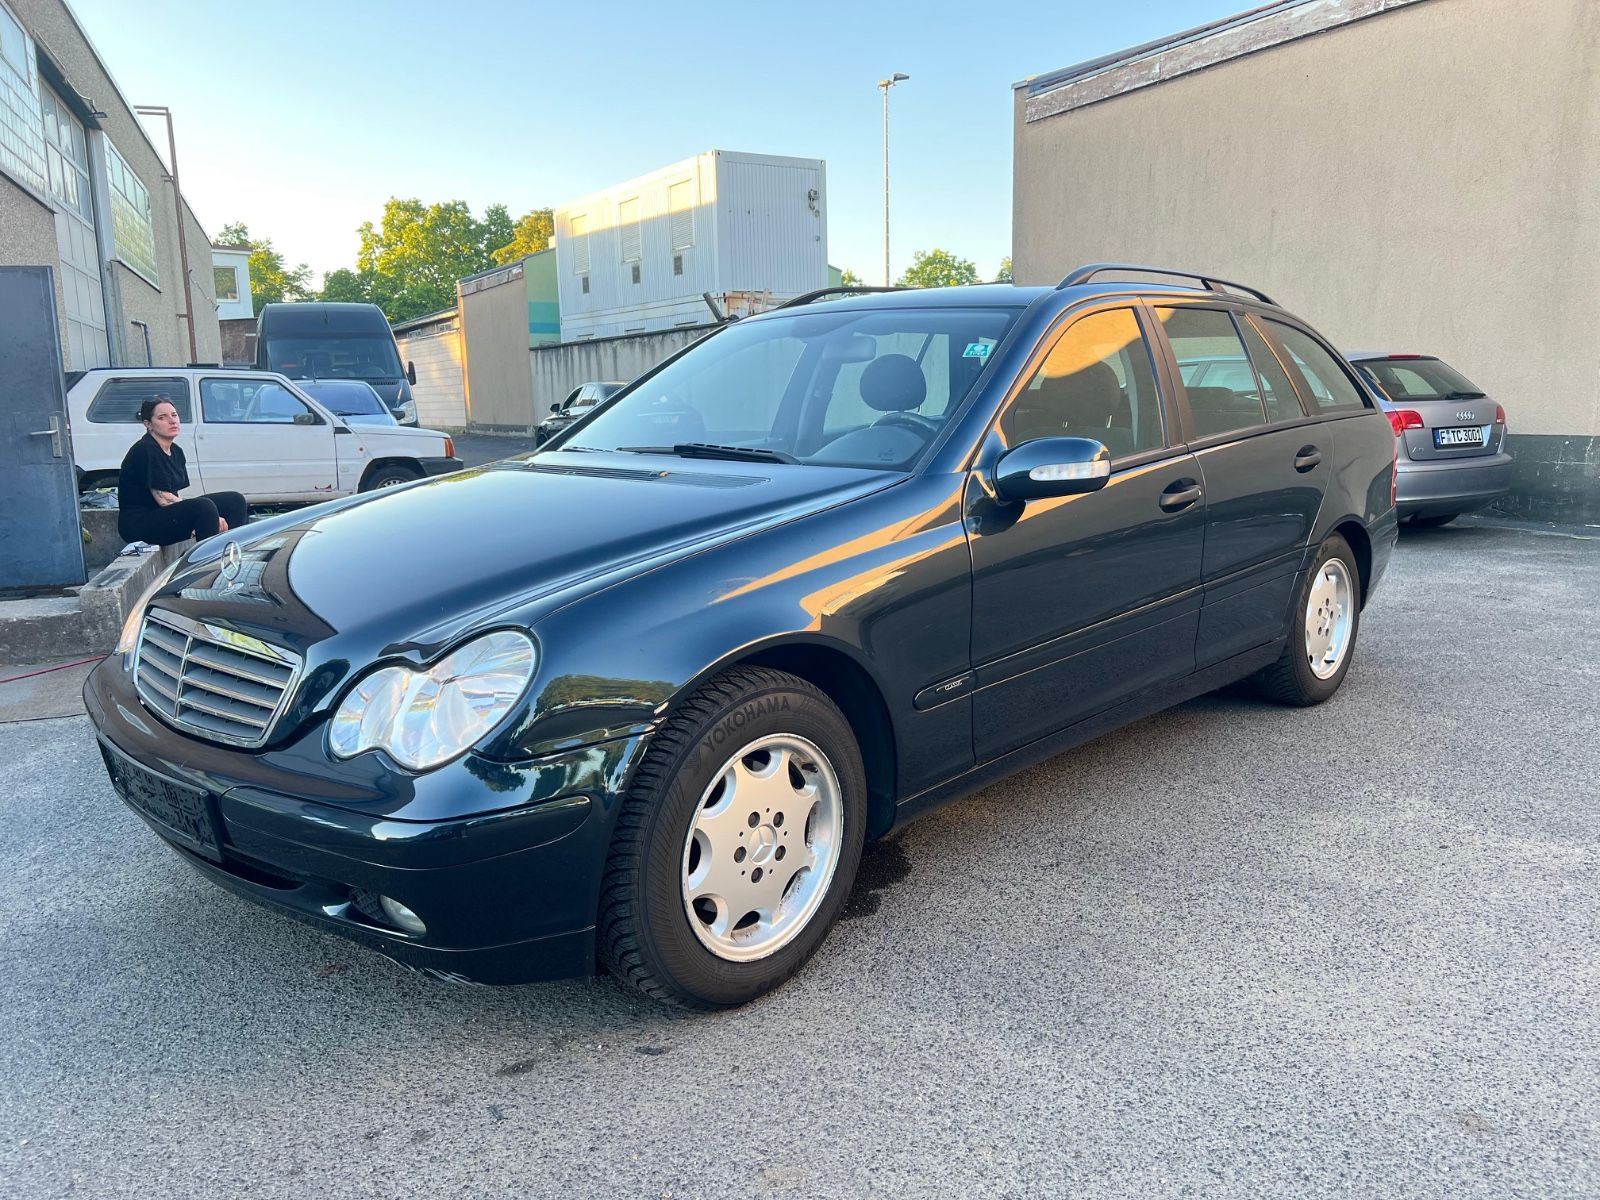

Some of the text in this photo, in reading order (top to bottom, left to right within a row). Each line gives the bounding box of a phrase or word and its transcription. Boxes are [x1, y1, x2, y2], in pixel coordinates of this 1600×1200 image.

[1440, 429, 1481, 443] F TC 3001
[702, 695, 791, 752] YOKOHAMA
